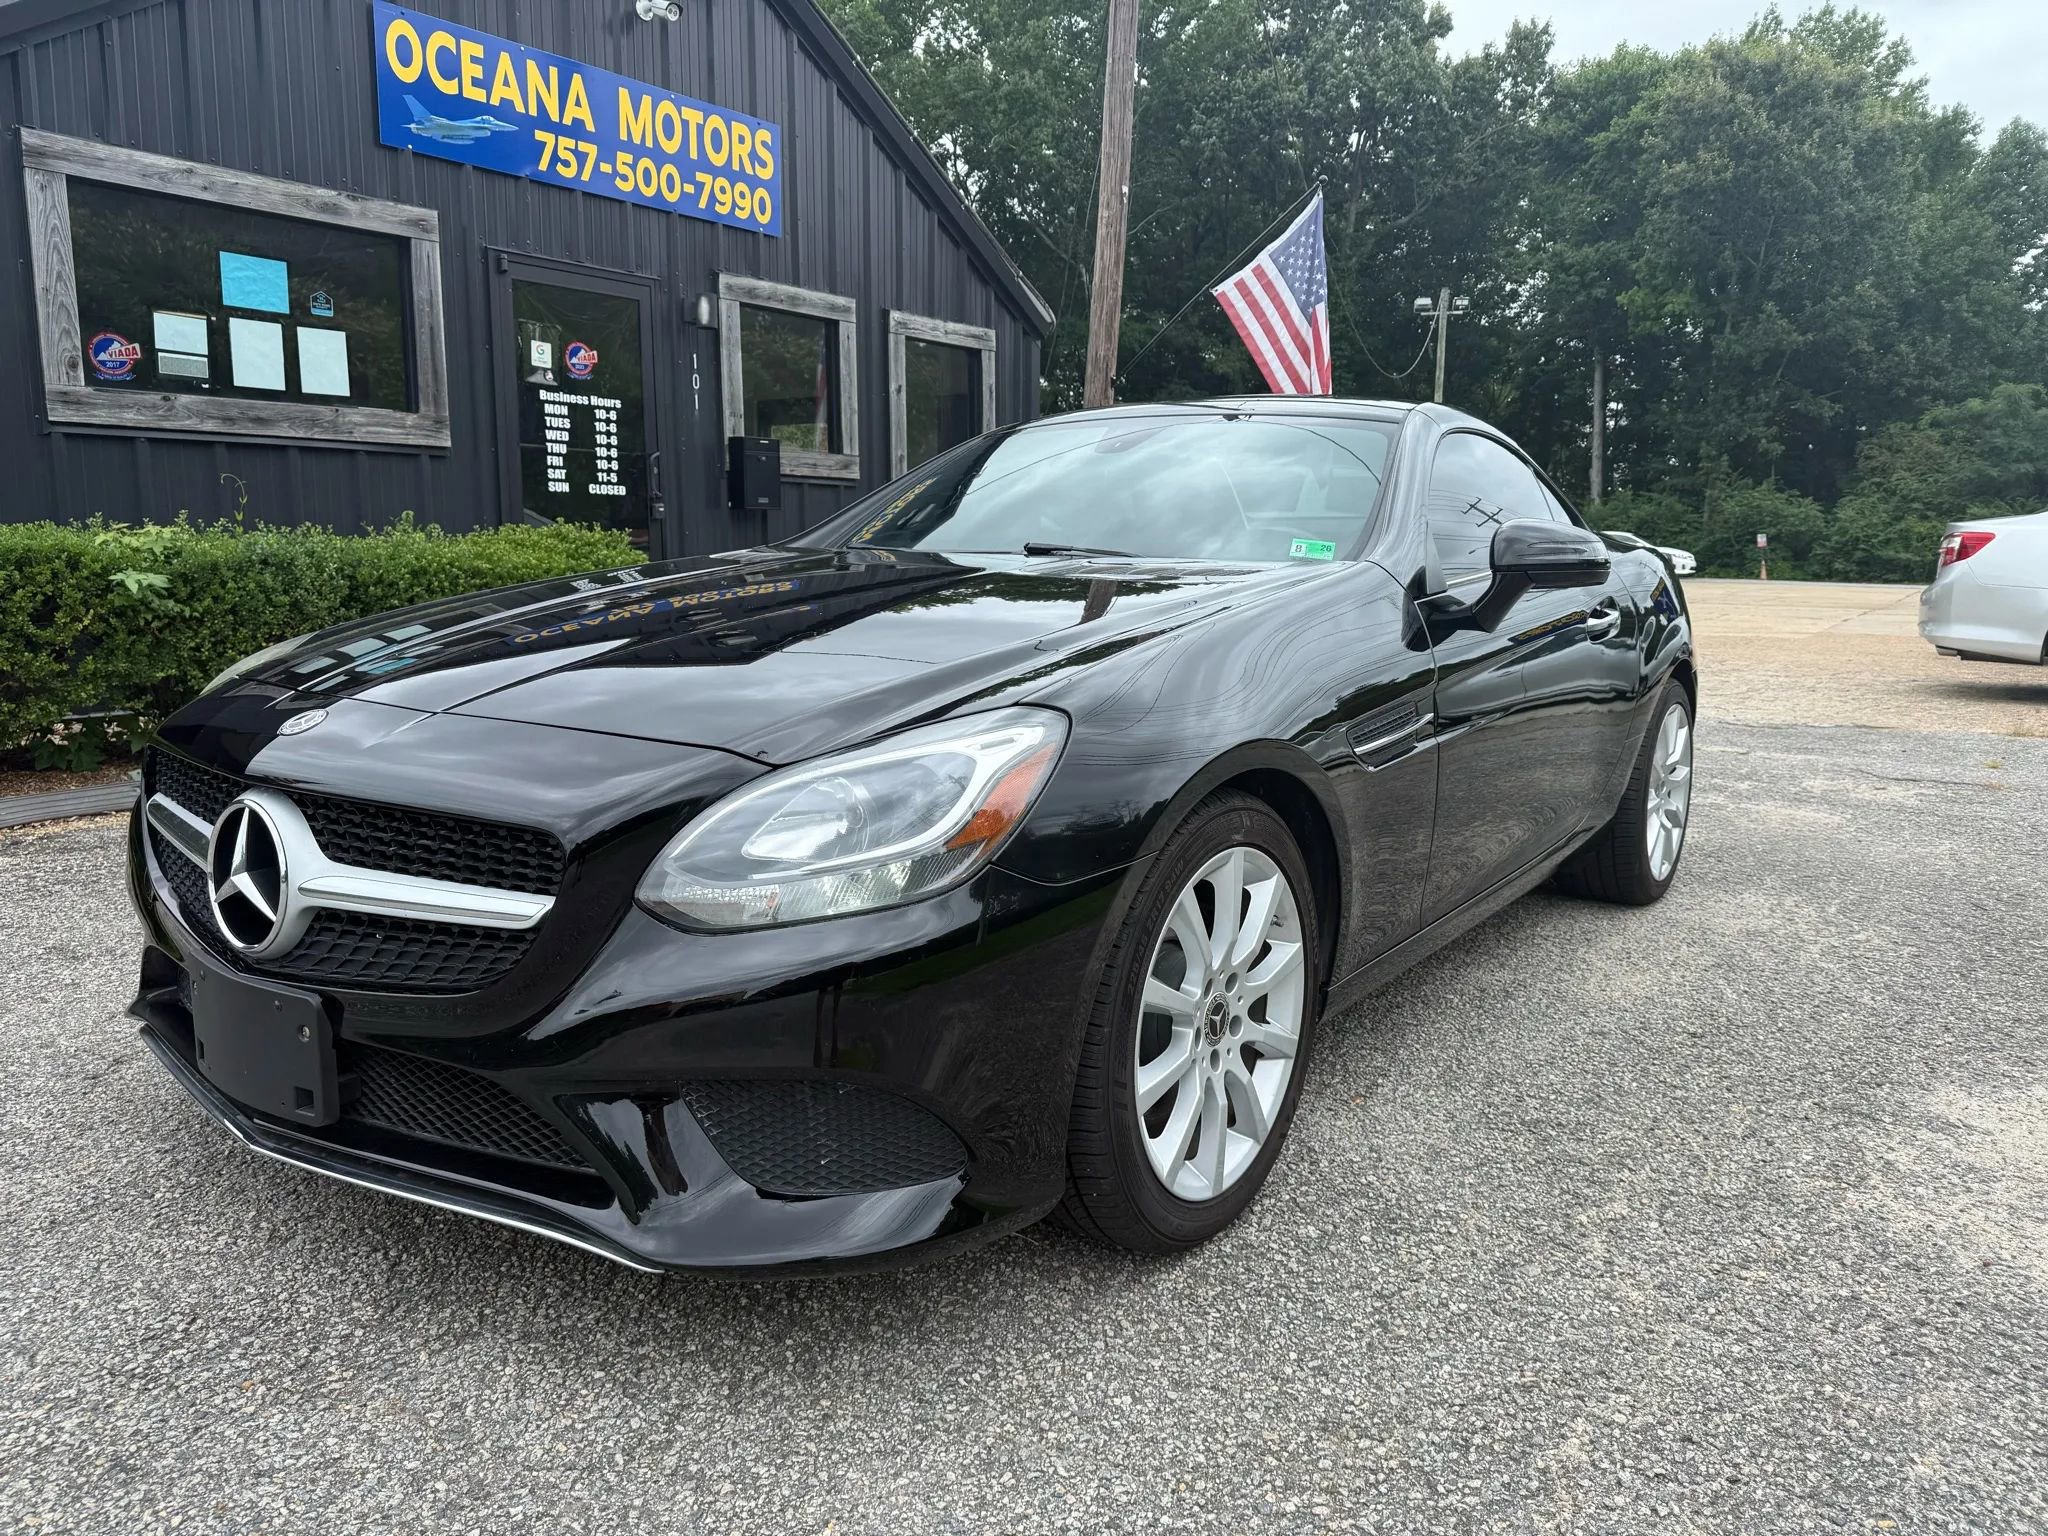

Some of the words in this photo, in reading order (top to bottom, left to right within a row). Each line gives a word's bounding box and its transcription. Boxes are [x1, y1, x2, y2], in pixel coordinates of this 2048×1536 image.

[386, 19, 596, 132] OCEANA
[618, 87, 774, 180] MOTORS
[534, 130, 772, 224] 757-500-7990
[107, 346, 139, 358] VIADA
[692, 353, 700, 410] 101
[539, 390, 589, 405] Business
[590, 396, 622, 408] Hours
[544, 404, 568, 416] MON
[594, 409, 617, 421] 10-6
[545, 417, 571, 429] TUES
[594, 422, 617, 433] 10-6
[545, 430, 569, 442] WED
[595, 434, 618, 446] 10-6
[546, 443, 567, 454] THU
[595, 447, 618, 458] 10-6
[547, 456, 563, 467] FRI
[596, 459, 619, 471] 10-6
[547, 469, 567, 480] SAT
[597, 472, 617, 483] 11-5
[548, 481, 569, 493] SUN
[588, 484, 626, 496] CLOSED
